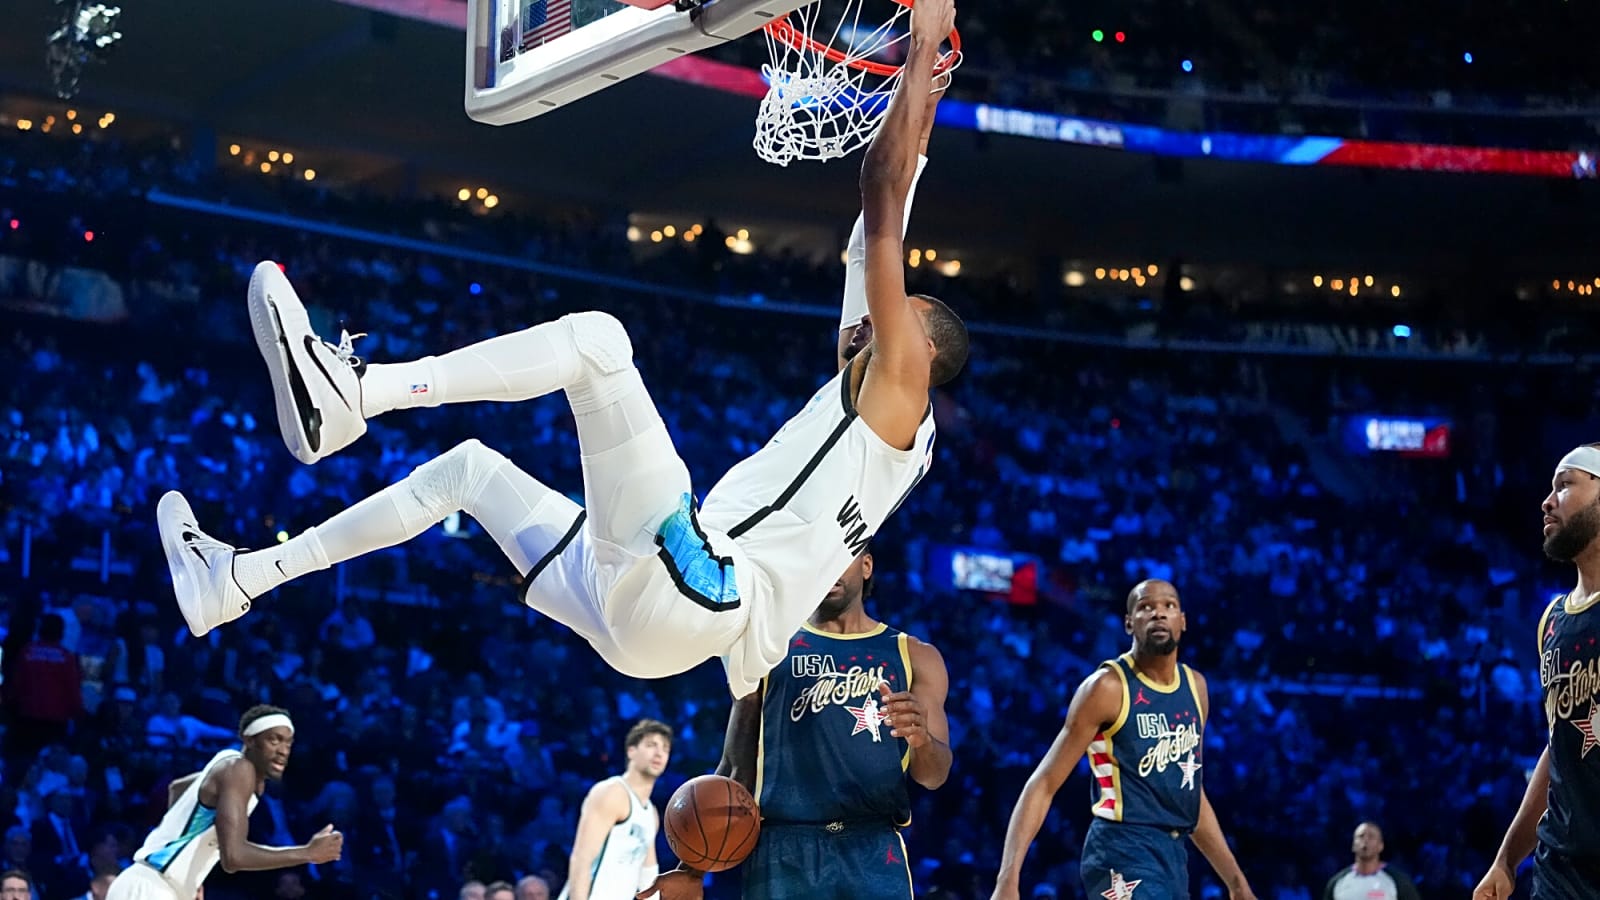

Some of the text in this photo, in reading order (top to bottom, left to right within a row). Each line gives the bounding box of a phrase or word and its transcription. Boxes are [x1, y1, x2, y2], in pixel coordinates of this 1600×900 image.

[791, 654, 838, 678] USA
[1556, 659, 1600, 719] Star
[1136, 712, 1170, 738] USA
